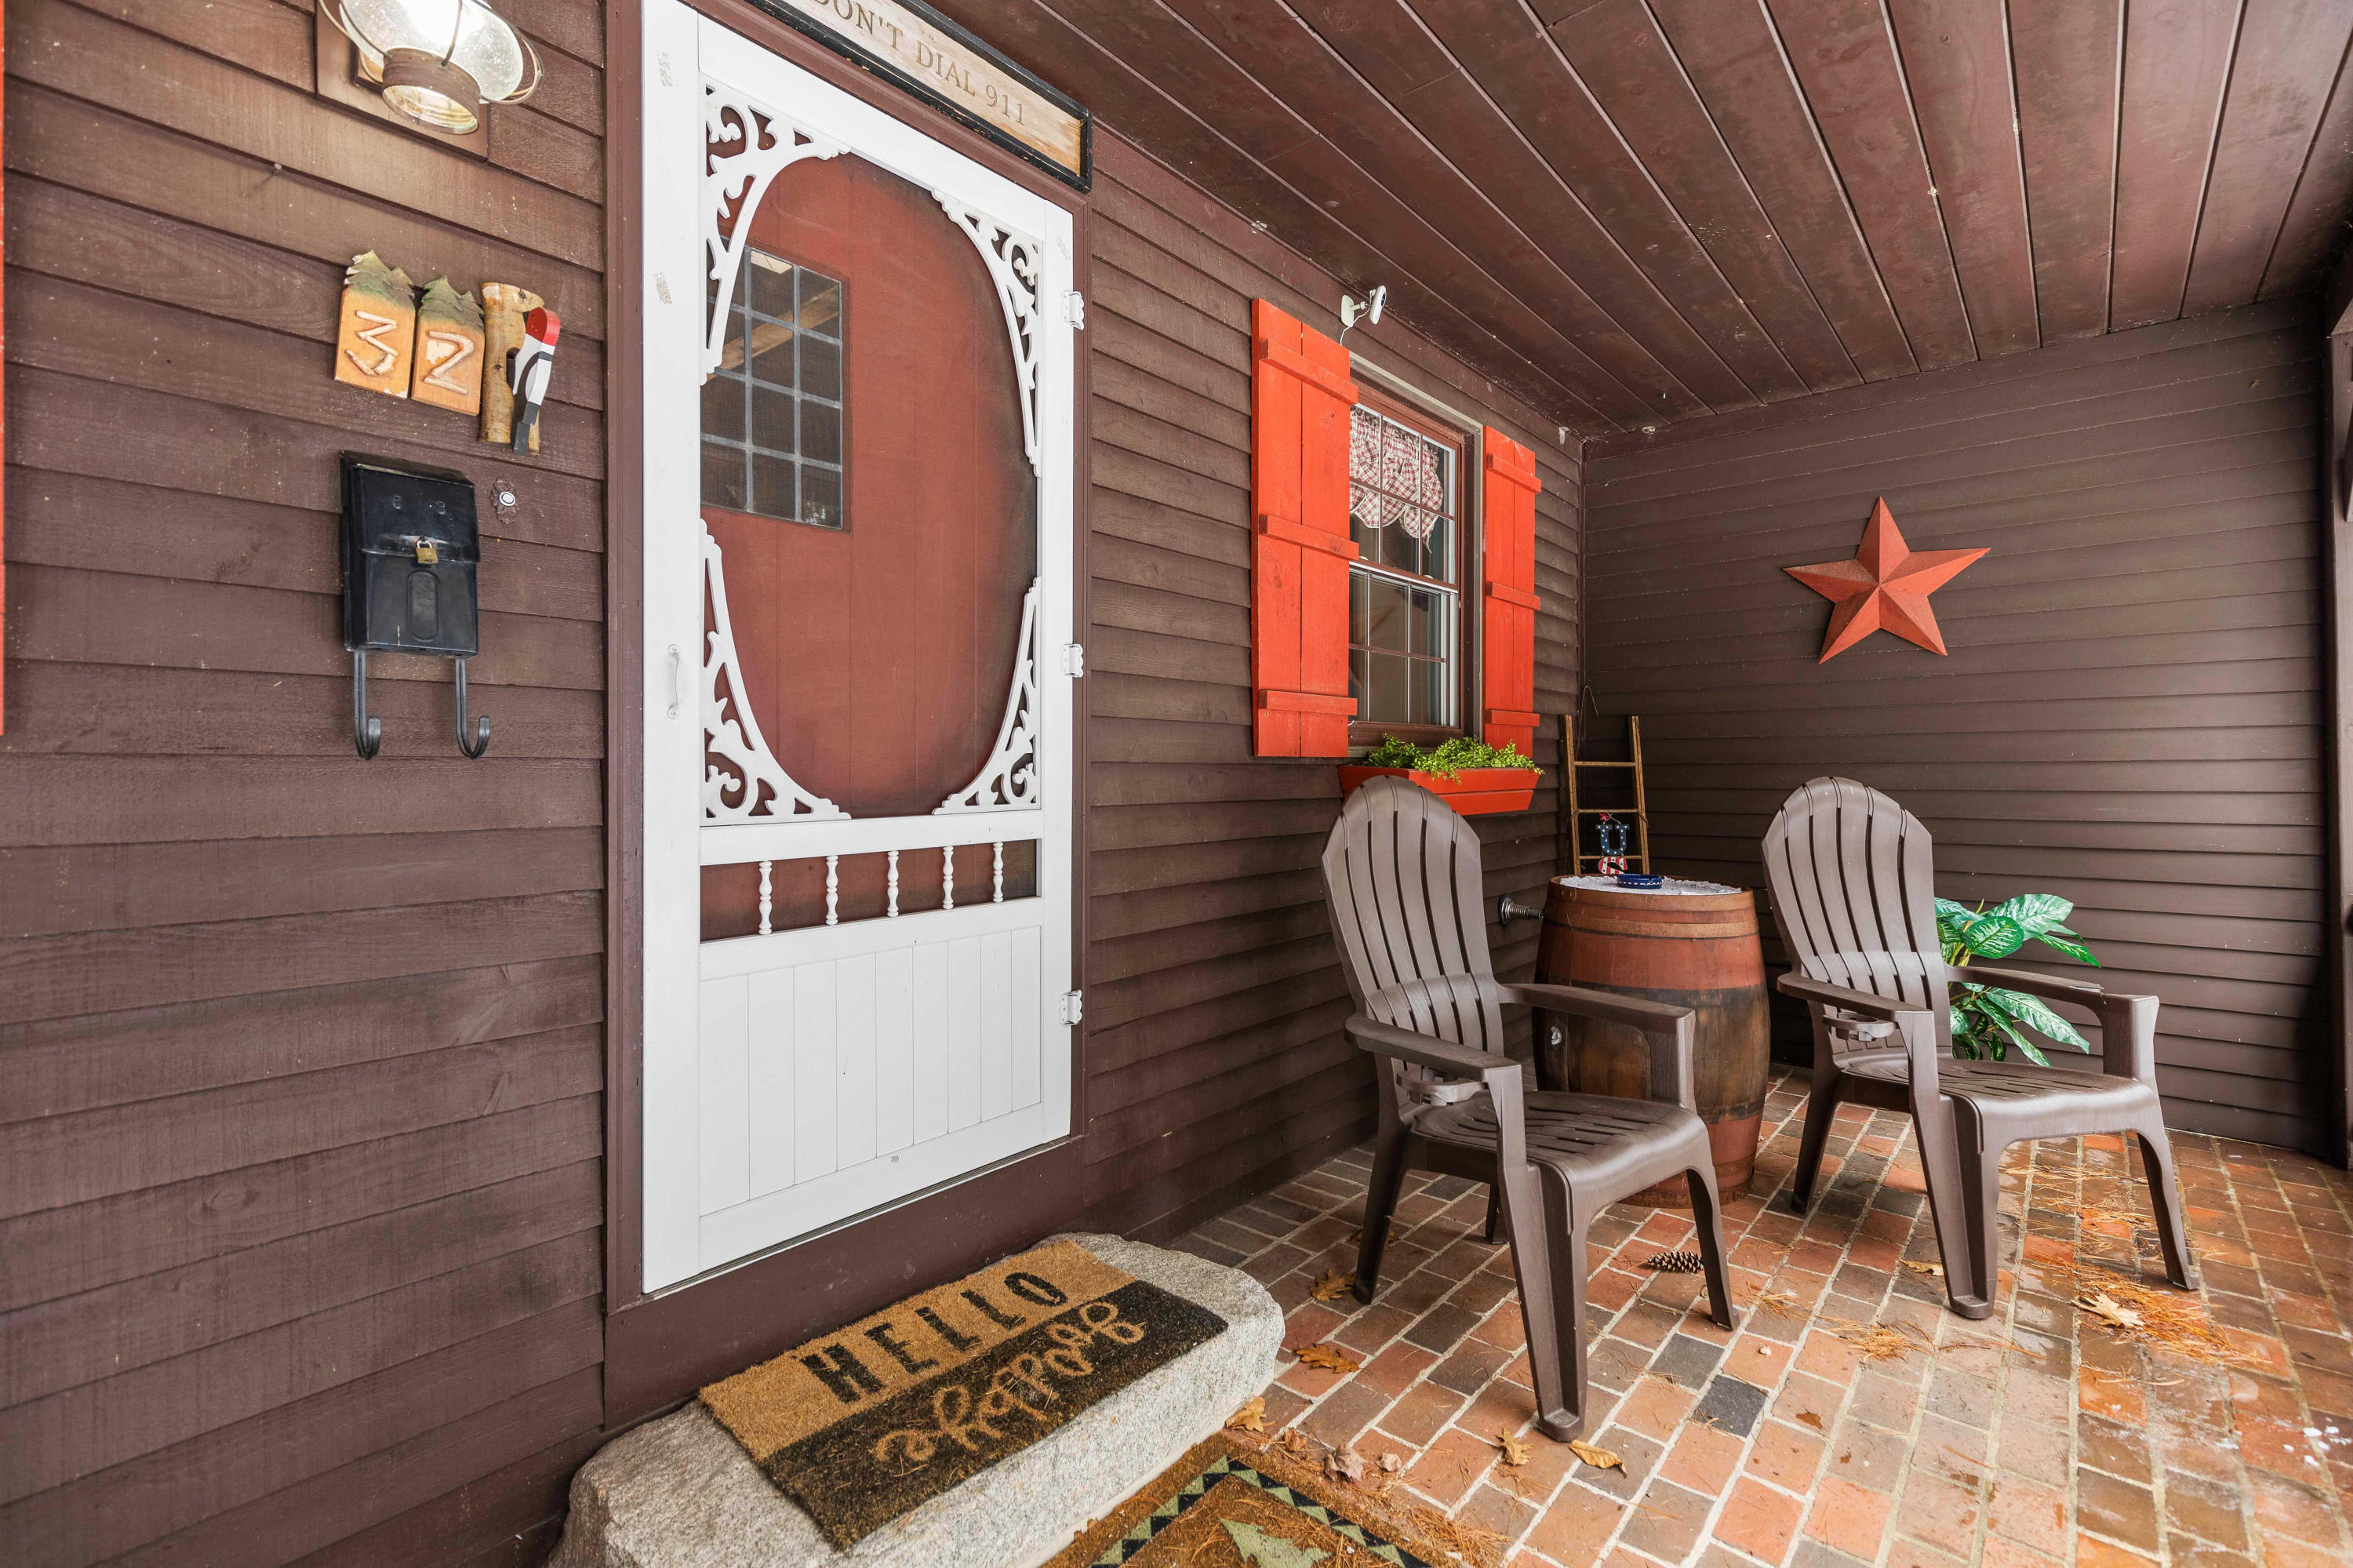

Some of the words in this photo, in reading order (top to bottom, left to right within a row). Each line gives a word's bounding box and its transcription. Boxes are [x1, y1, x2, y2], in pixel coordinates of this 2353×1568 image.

[813, 0, 904, 51] ON'T
[915, 40, 976, 97] DIAL
[985, 84, 1025, 126] 911
[344, 311, 475, 395] 32
[798, 1271, 1068, 1404] HELLO
[875, 1302, 1145, 1462] goodbye
